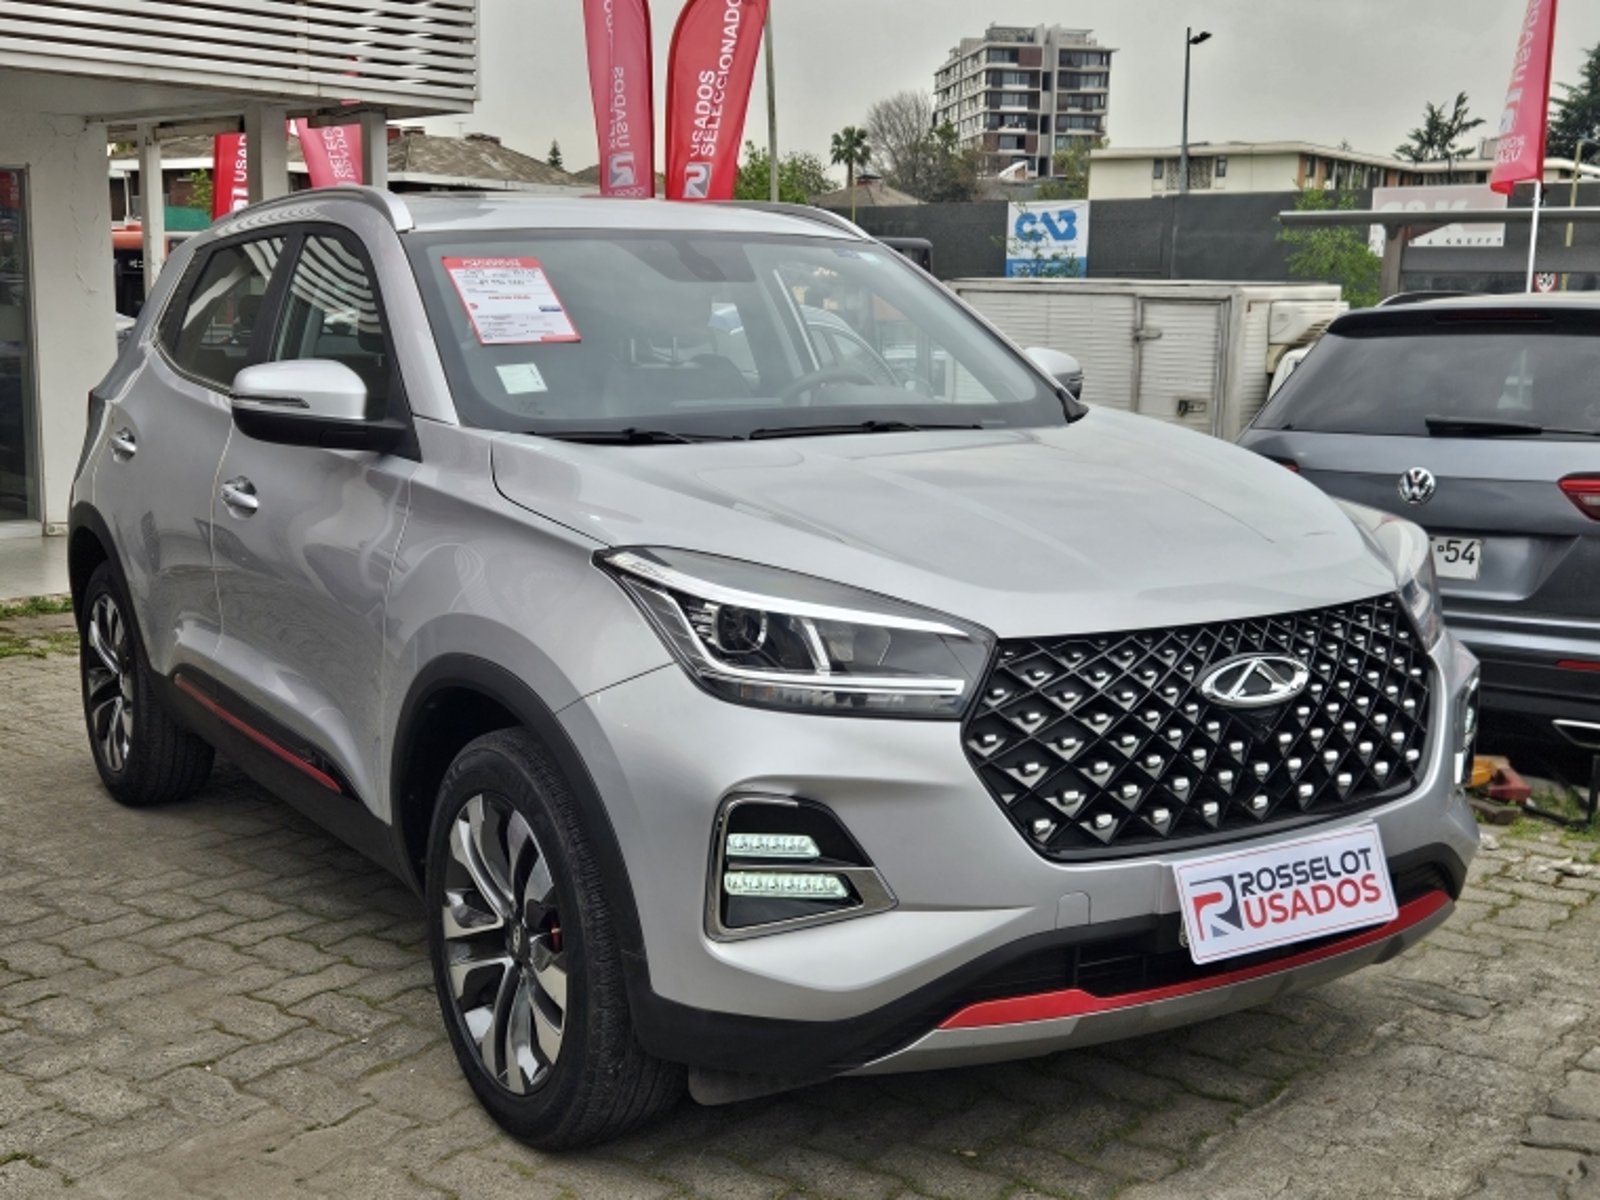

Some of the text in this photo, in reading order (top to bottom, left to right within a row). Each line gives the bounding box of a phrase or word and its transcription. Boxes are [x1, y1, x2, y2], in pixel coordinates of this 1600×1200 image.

[690, 70, 715, 157] USADOS
[1238, 848, 1371, 897] ROSSELOT
[1243, 873, 1381, 929] USADOS
